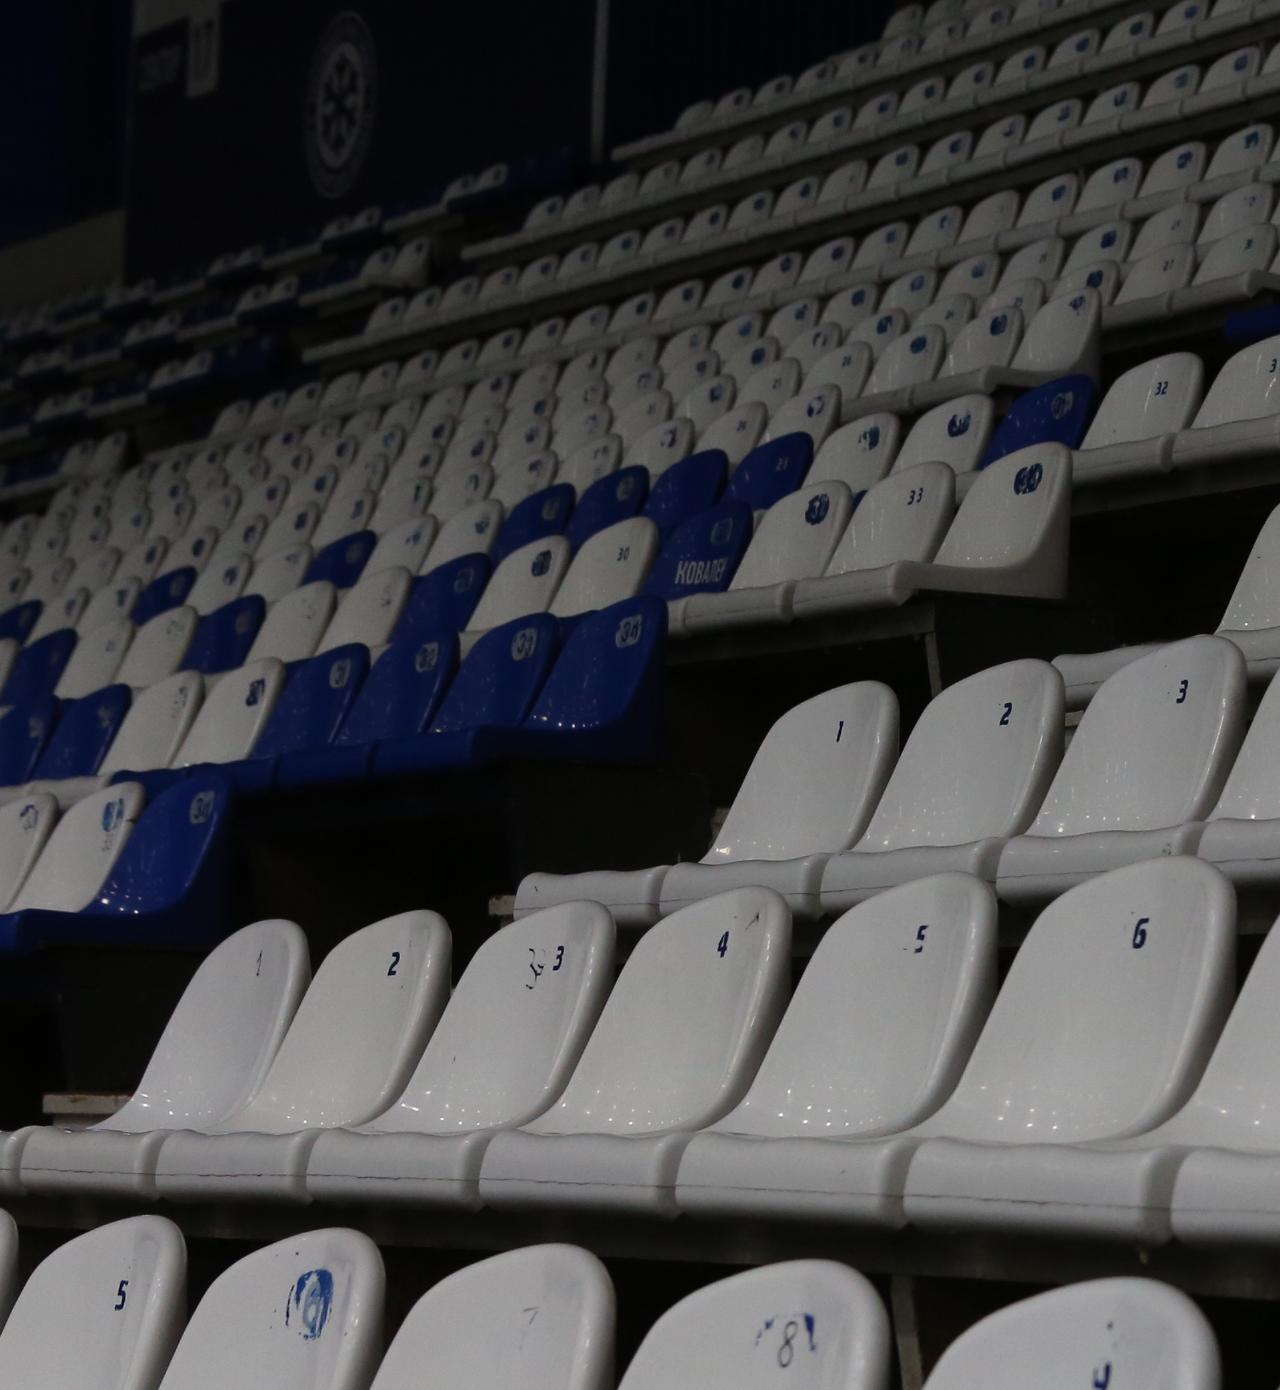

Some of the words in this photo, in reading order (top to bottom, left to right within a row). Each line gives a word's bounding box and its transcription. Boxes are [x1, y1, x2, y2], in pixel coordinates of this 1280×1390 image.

[1154, 380, 1169, 396] 32
[907, 487, 924, 506] 33
[1175, 679, 1189, 704] 3
[999, 702, 1013, 726] 2
[836, 720, 845, 743] 1
[716, 930, 729, 959] 4
[914, 924, 929, 954] 5
[1132, 917, 1150, 950] 6
[387, 951, 401, 977] 2
[552, 945, 565, 971] 3
[114, 1279, 129, 1311] 5
[776, 1320, 799, 1369] 8
